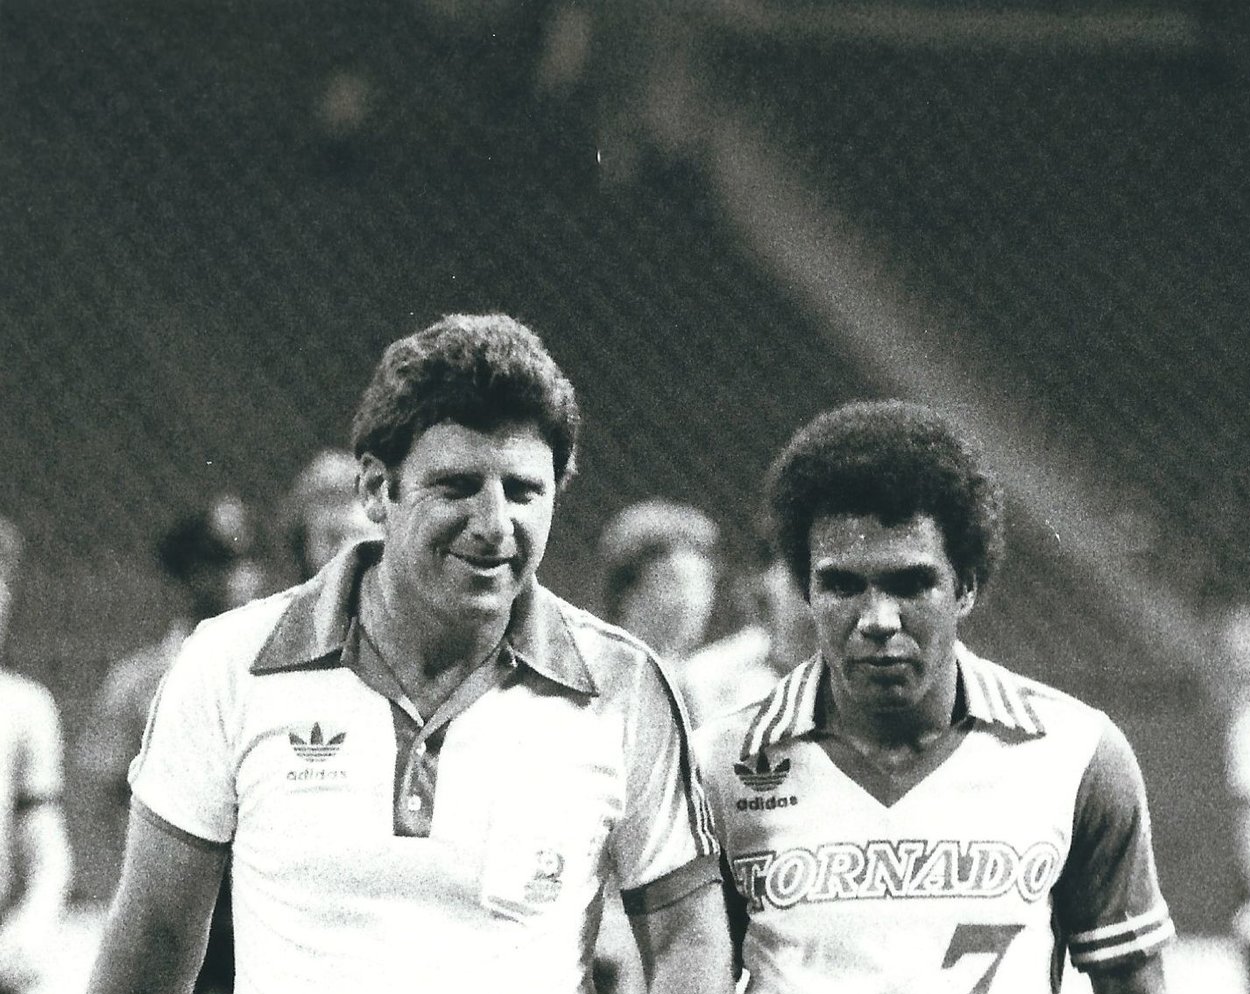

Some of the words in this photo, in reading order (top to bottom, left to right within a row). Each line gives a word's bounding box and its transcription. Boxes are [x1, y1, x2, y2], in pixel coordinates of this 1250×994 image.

[286, 769, 348, 781] adidas
[736, 794, 799, 811] adidas
[732, 839, 1061, 914] TORNADO
